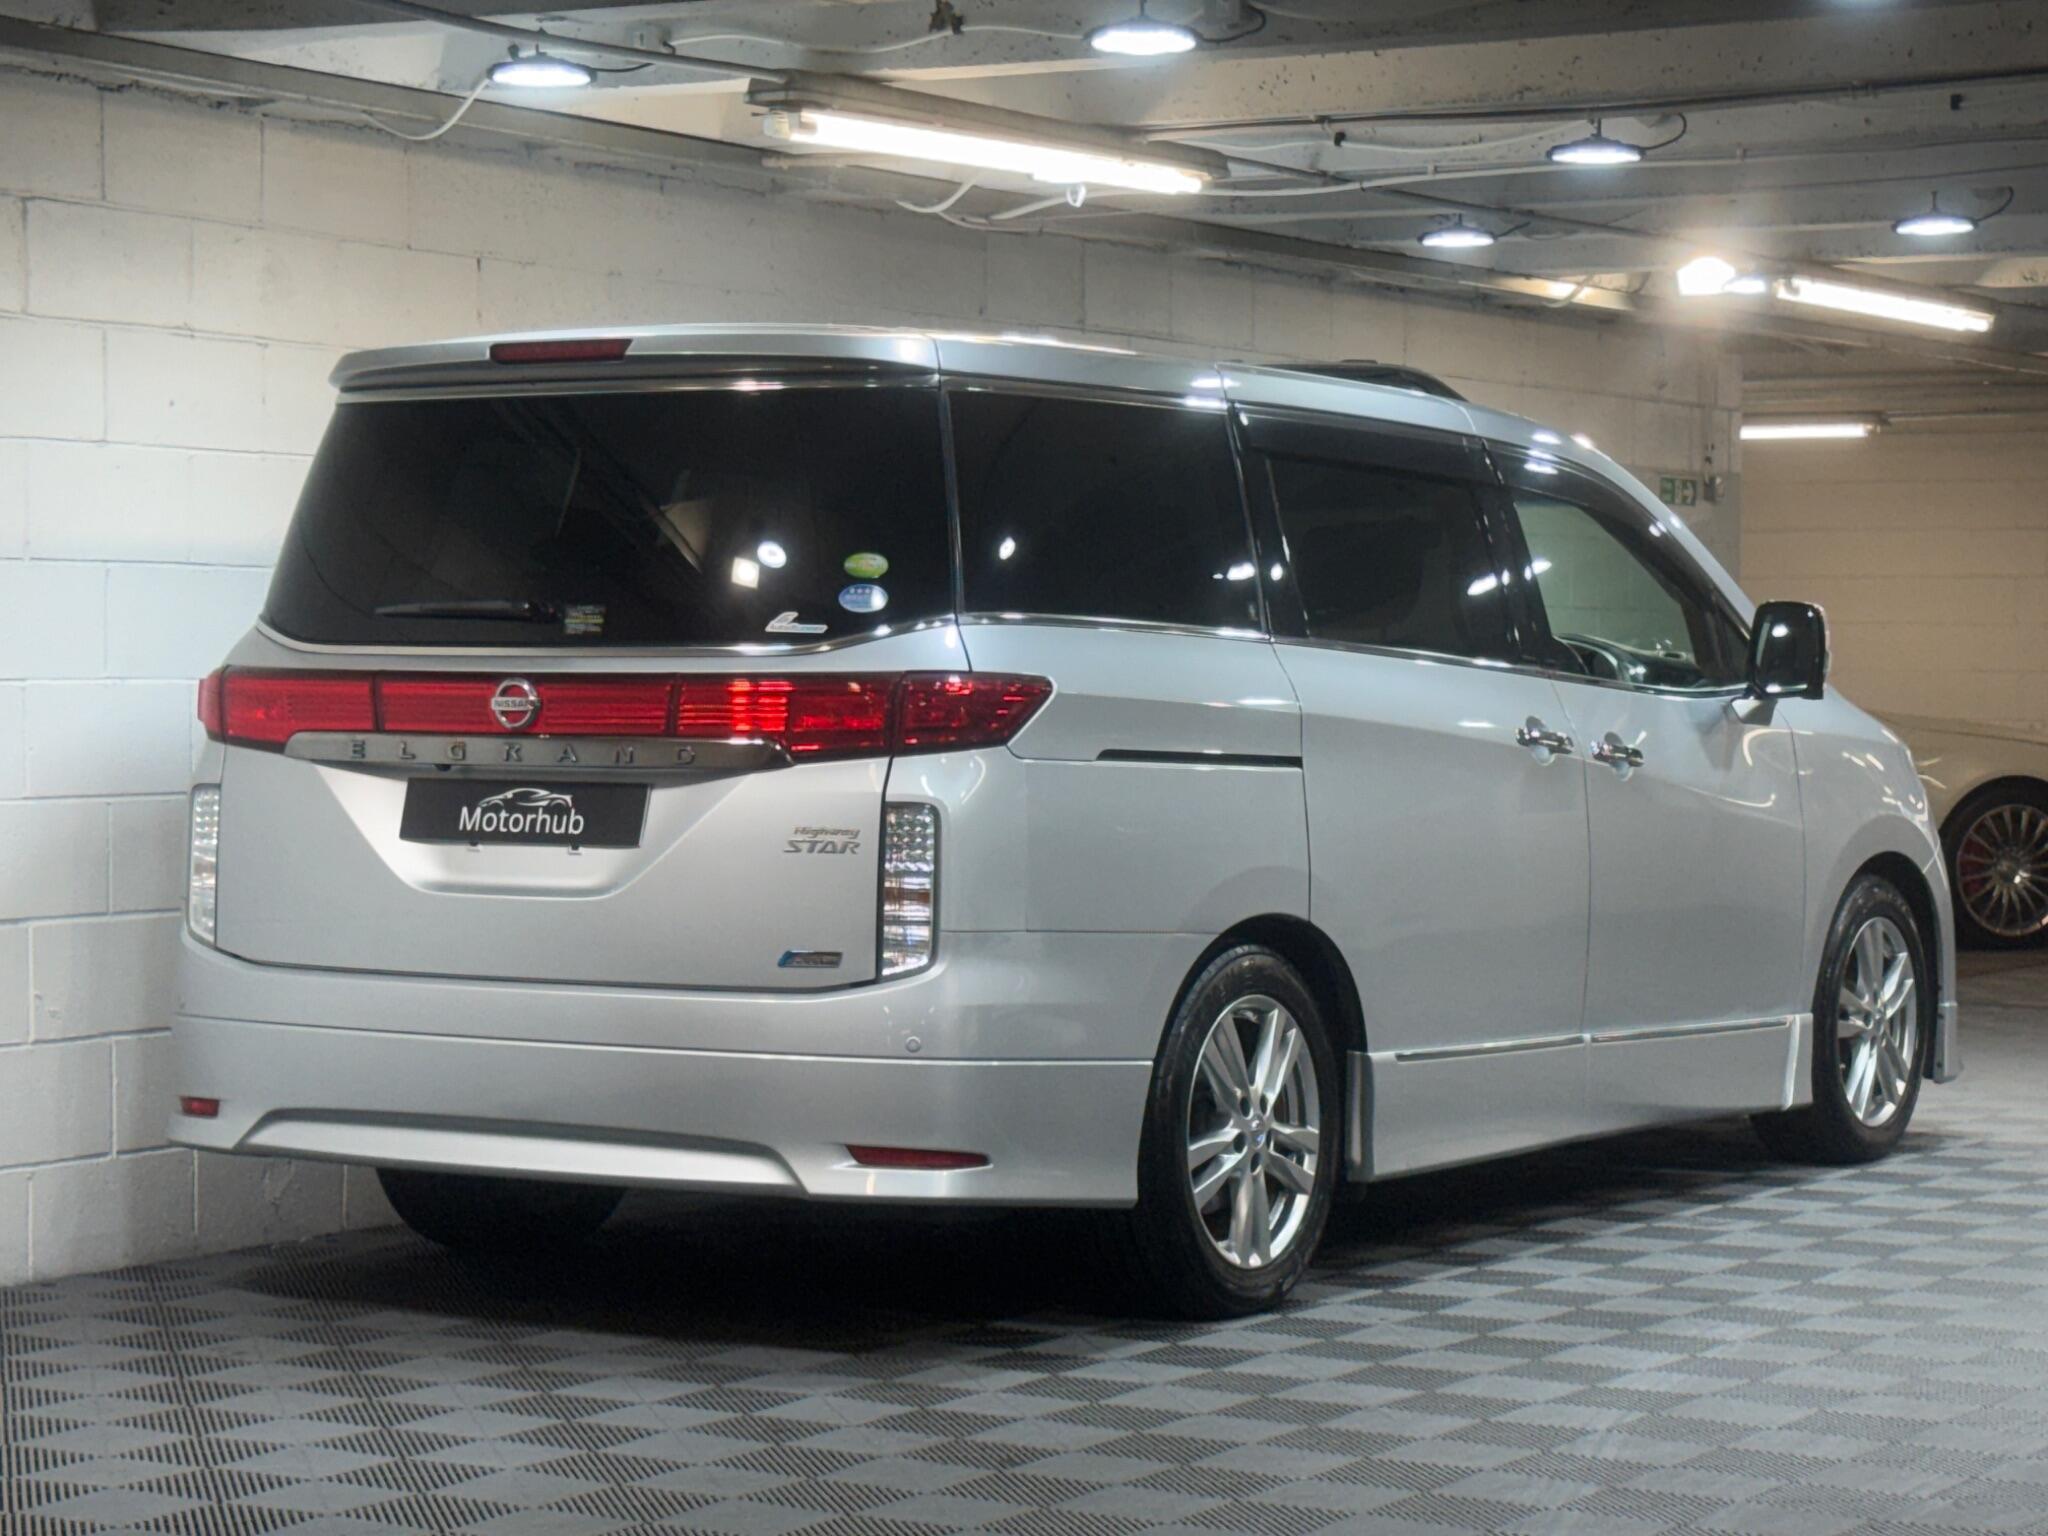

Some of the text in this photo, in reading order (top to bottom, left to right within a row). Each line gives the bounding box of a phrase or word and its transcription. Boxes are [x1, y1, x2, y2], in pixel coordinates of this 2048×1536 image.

[494, 699, 534, 708] NISSAN
[351, 739, 696, 765] ELGRAND
[459, 806, 584, 835] Motorhub
[794, 826, 861, 839] Highway
[783, 840, 861, 854] STAR
